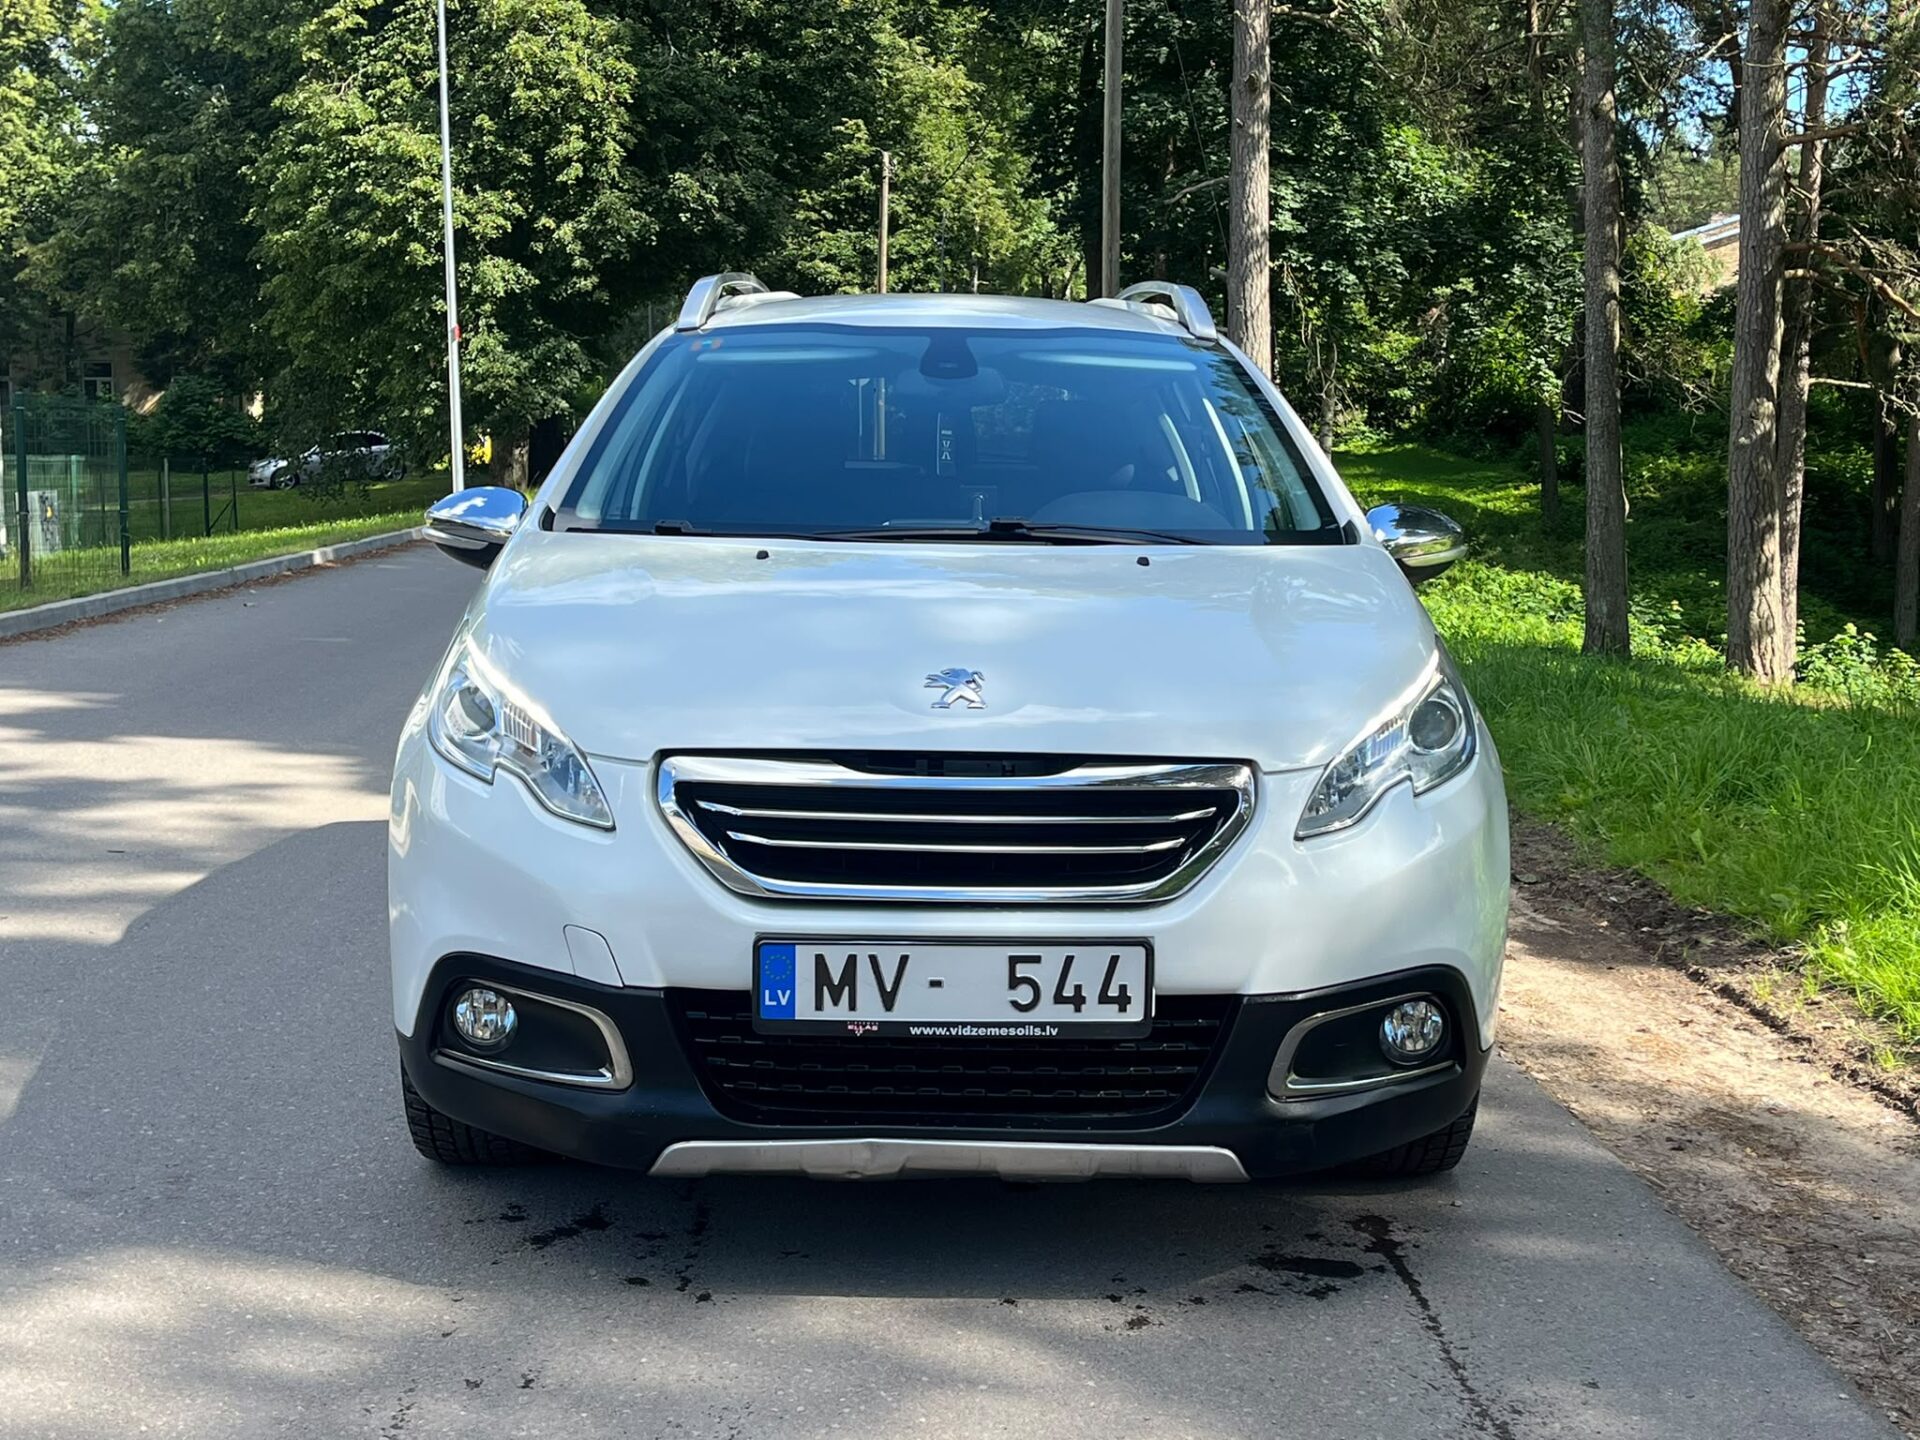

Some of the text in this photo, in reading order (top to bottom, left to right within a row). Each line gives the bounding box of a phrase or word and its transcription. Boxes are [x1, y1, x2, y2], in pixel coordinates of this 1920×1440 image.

[1007, 954, 1133, 1013] 544
[764, 989, 791, 1006] LV
[909, 1024, 1059, 1037] www.vidzemesoils.lv
